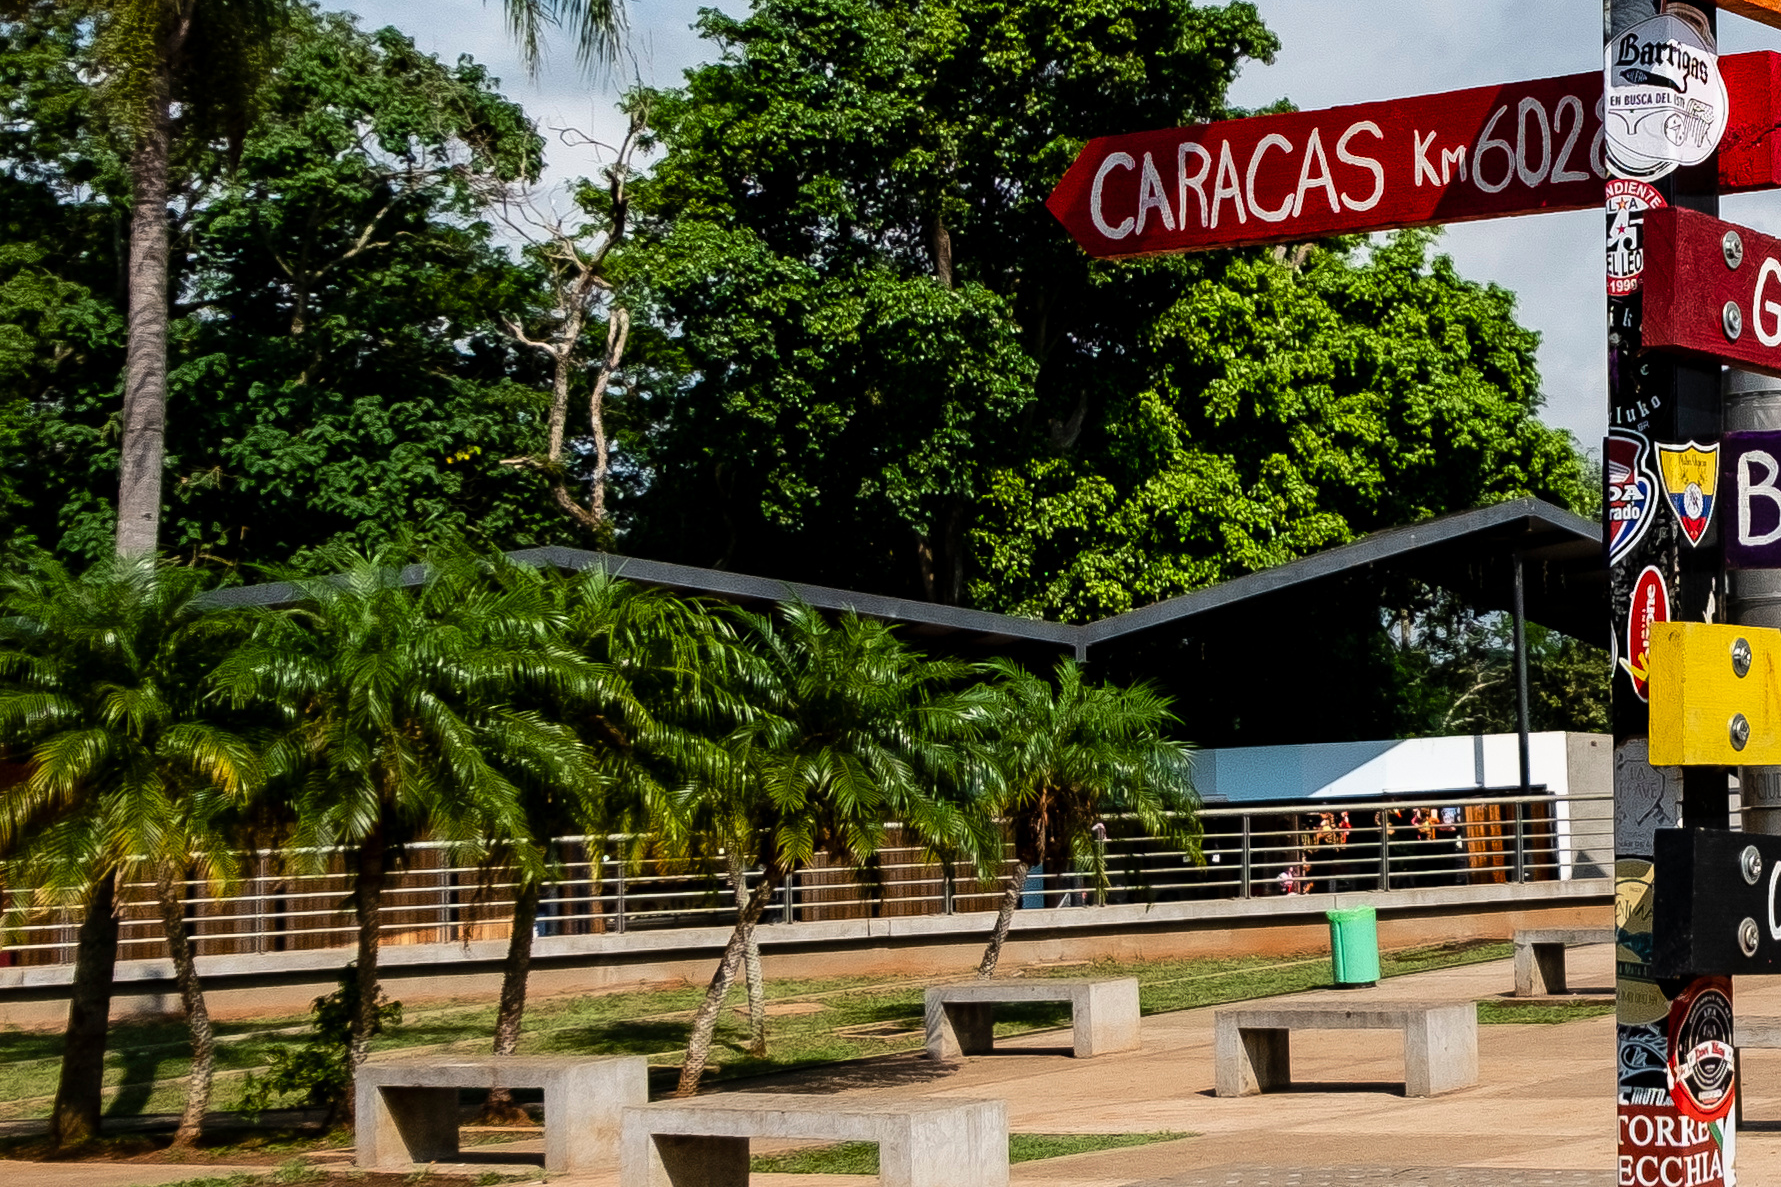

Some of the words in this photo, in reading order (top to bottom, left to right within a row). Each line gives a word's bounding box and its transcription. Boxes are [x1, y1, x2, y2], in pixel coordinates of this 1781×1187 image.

[1614, 32, 1708, 86] Barrigas
[1624, 93, 1653, 106] BUSCA
[1655, 92, 1672, 104] DEL
[1088, 119, 1385, 241] CARACAS
